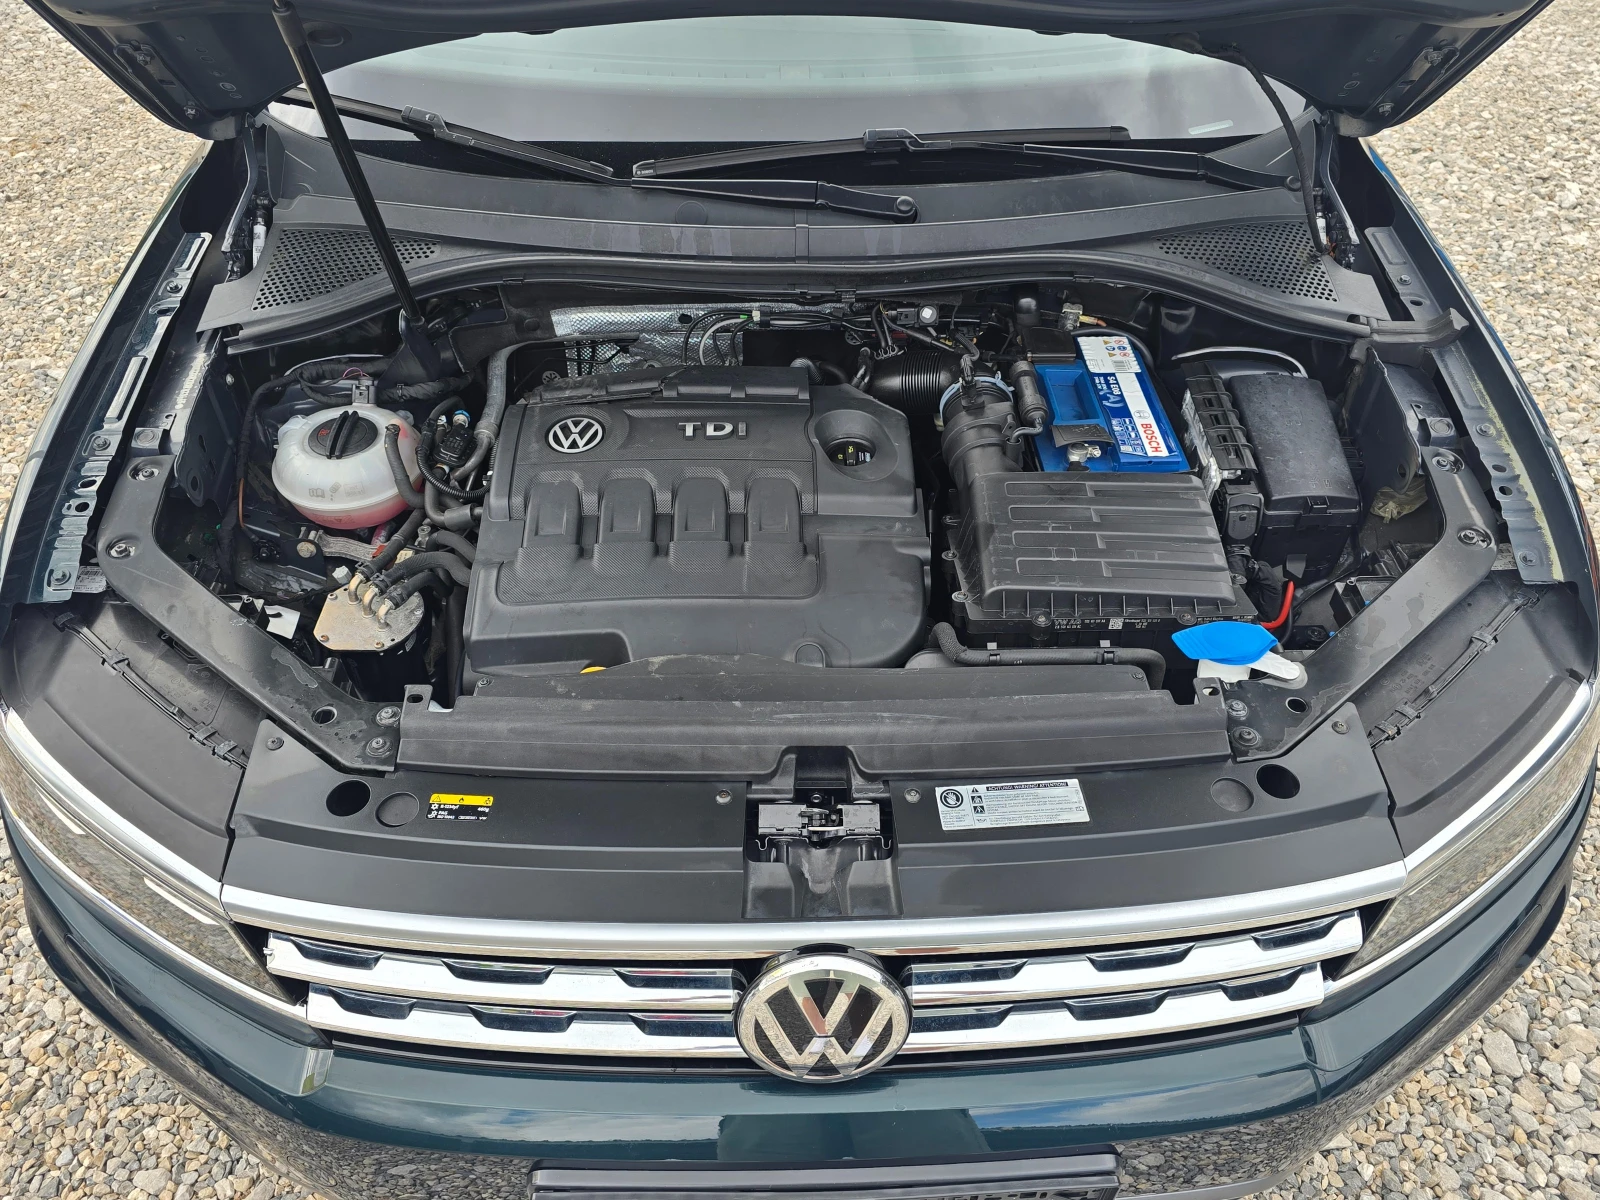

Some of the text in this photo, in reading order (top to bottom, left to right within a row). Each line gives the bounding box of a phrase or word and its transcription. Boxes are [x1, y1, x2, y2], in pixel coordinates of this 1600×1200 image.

[548, 417, 603, 454] VW
[678, 422, 747, 437] TDI
[1141, 423, 1163, 453] BOSCH
[737, 954, 911, 1082] VW
